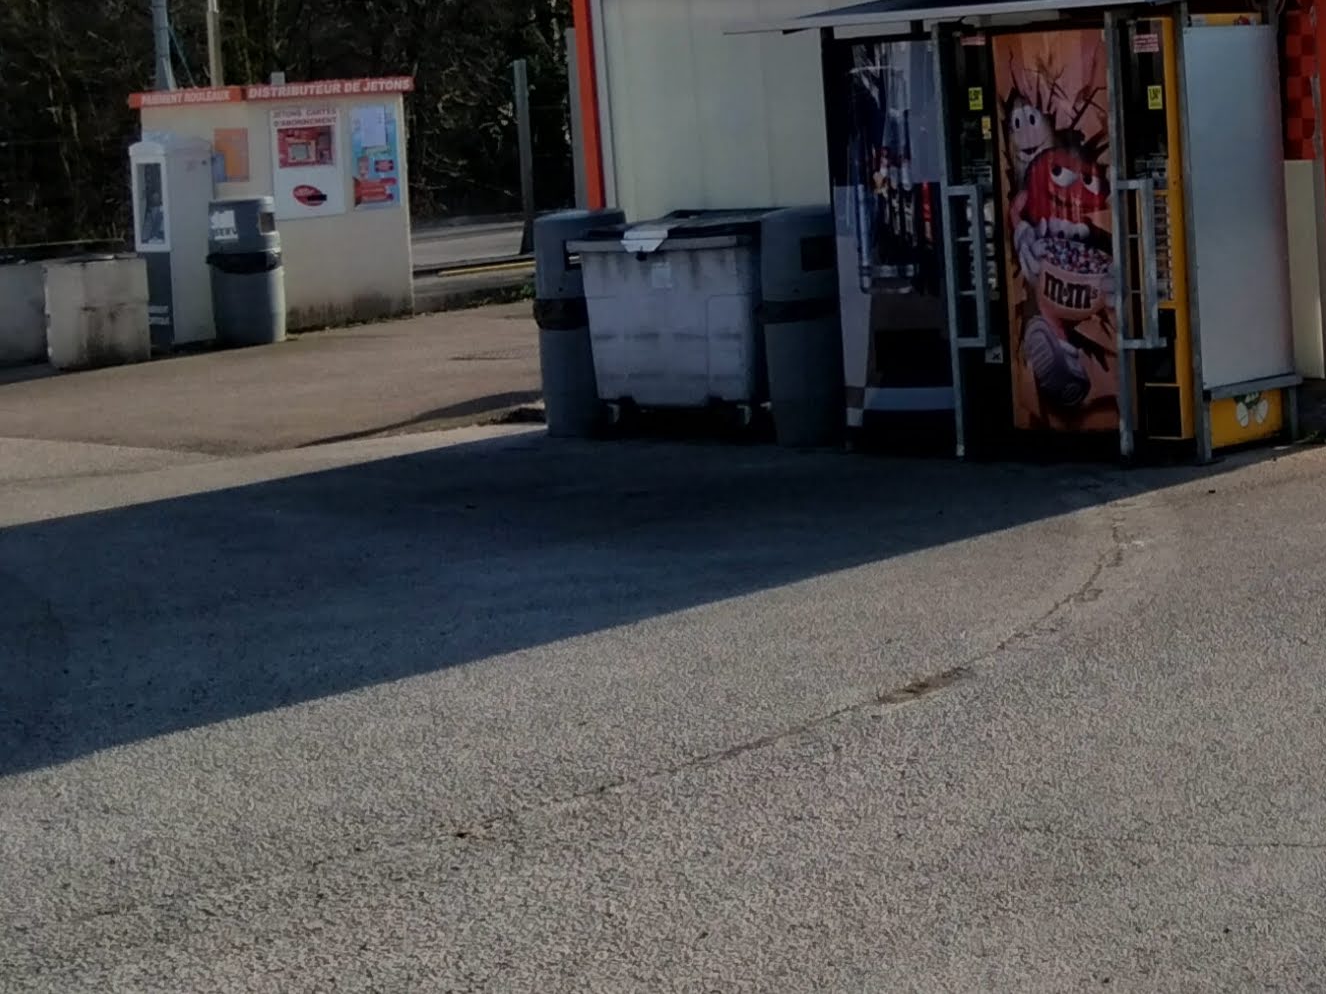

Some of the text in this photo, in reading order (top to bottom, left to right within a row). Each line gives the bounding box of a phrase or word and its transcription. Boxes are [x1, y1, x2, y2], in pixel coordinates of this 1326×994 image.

[248, 79, 410, 99] DISTRIBUTEUR DE JETONS
